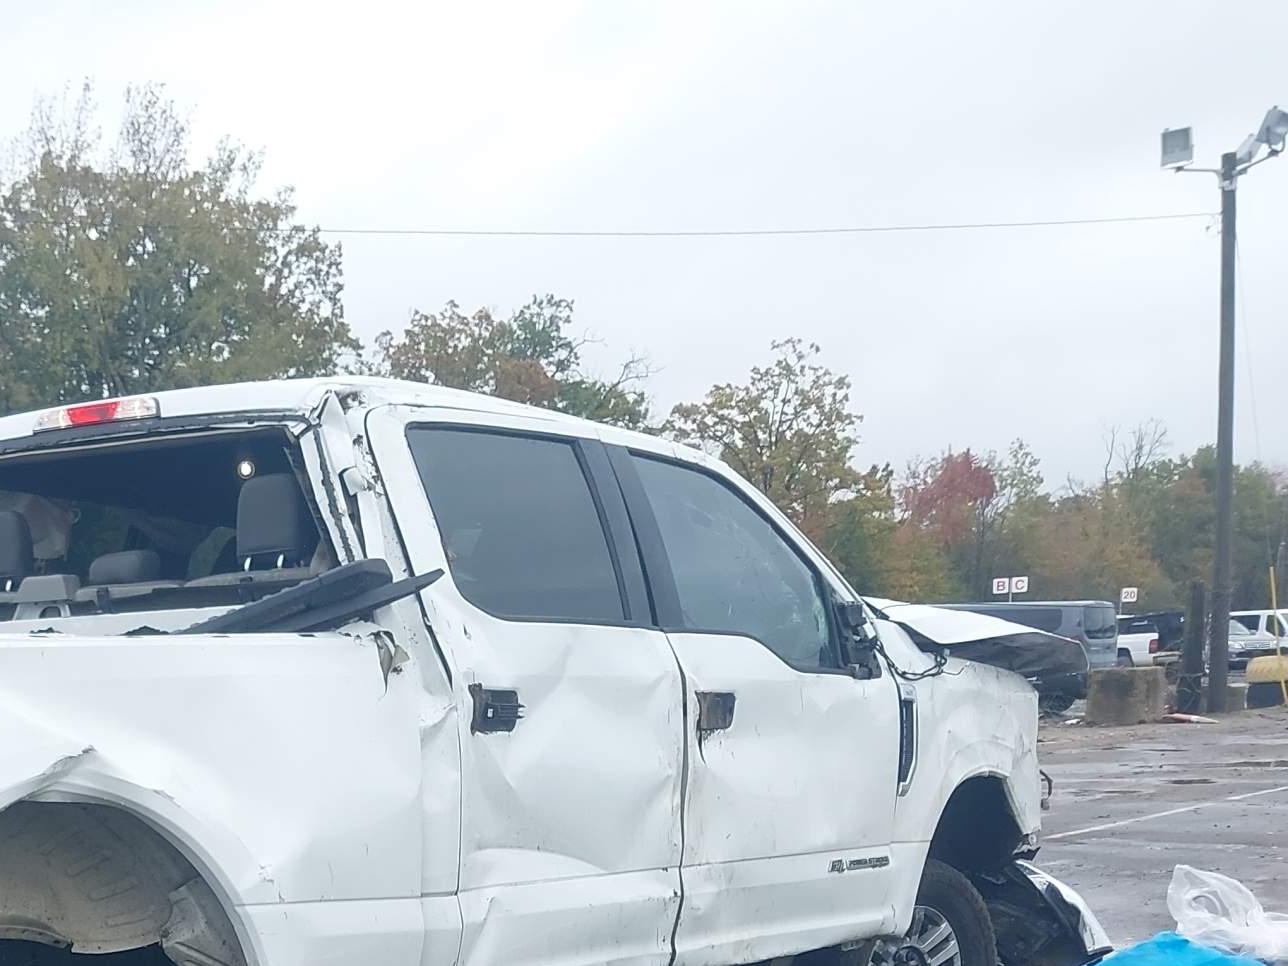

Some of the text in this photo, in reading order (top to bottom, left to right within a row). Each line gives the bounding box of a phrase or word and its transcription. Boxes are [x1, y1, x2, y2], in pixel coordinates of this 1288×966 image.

[996, 580, 1006, 592] B
[1014, 579, 1025, 591] C
[1123, 590, 1136, 600] 20
